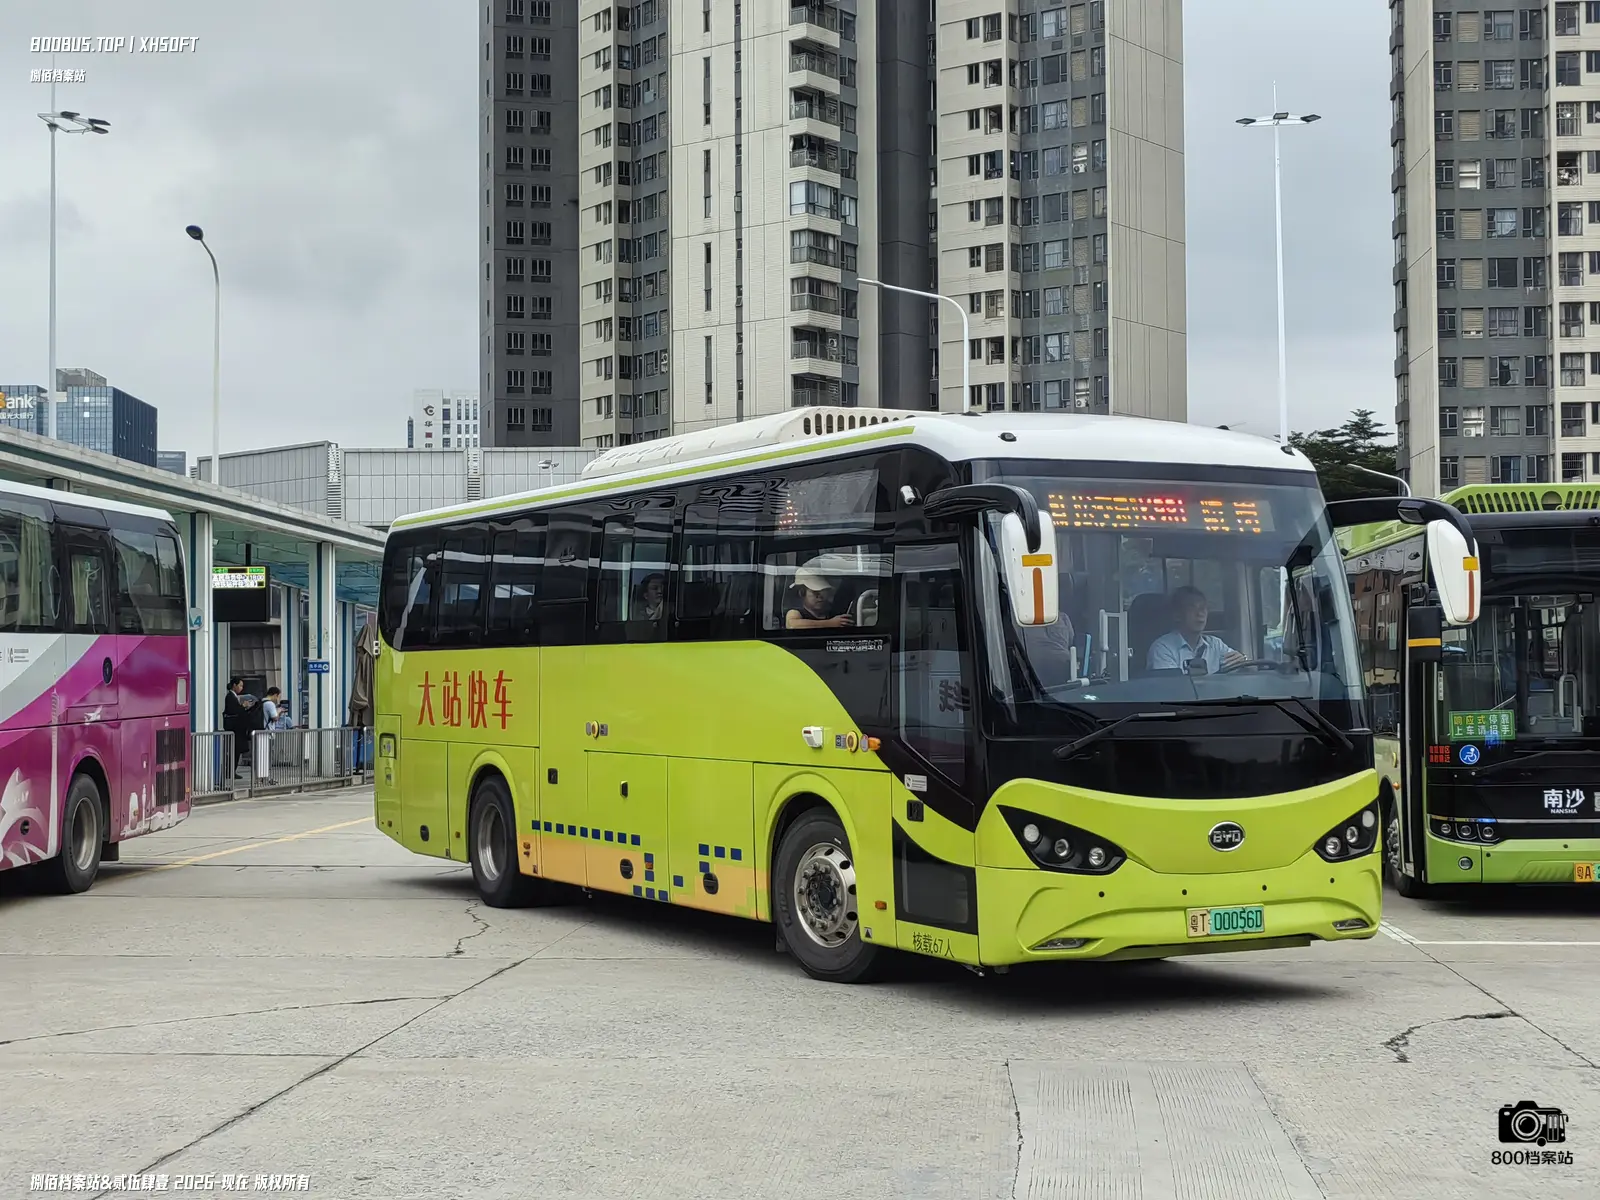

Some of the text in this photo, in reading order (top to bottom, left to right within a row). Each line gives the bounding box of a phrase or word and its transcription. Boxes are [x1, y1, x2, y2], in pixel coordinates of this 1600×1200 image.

[417, 669, 514, 730] 大站快车
[1543, 788, 1586, 809] 南沙
[1212, 829, 1242, 844] BYD
[912, 931, 956, 959] 核载67人
